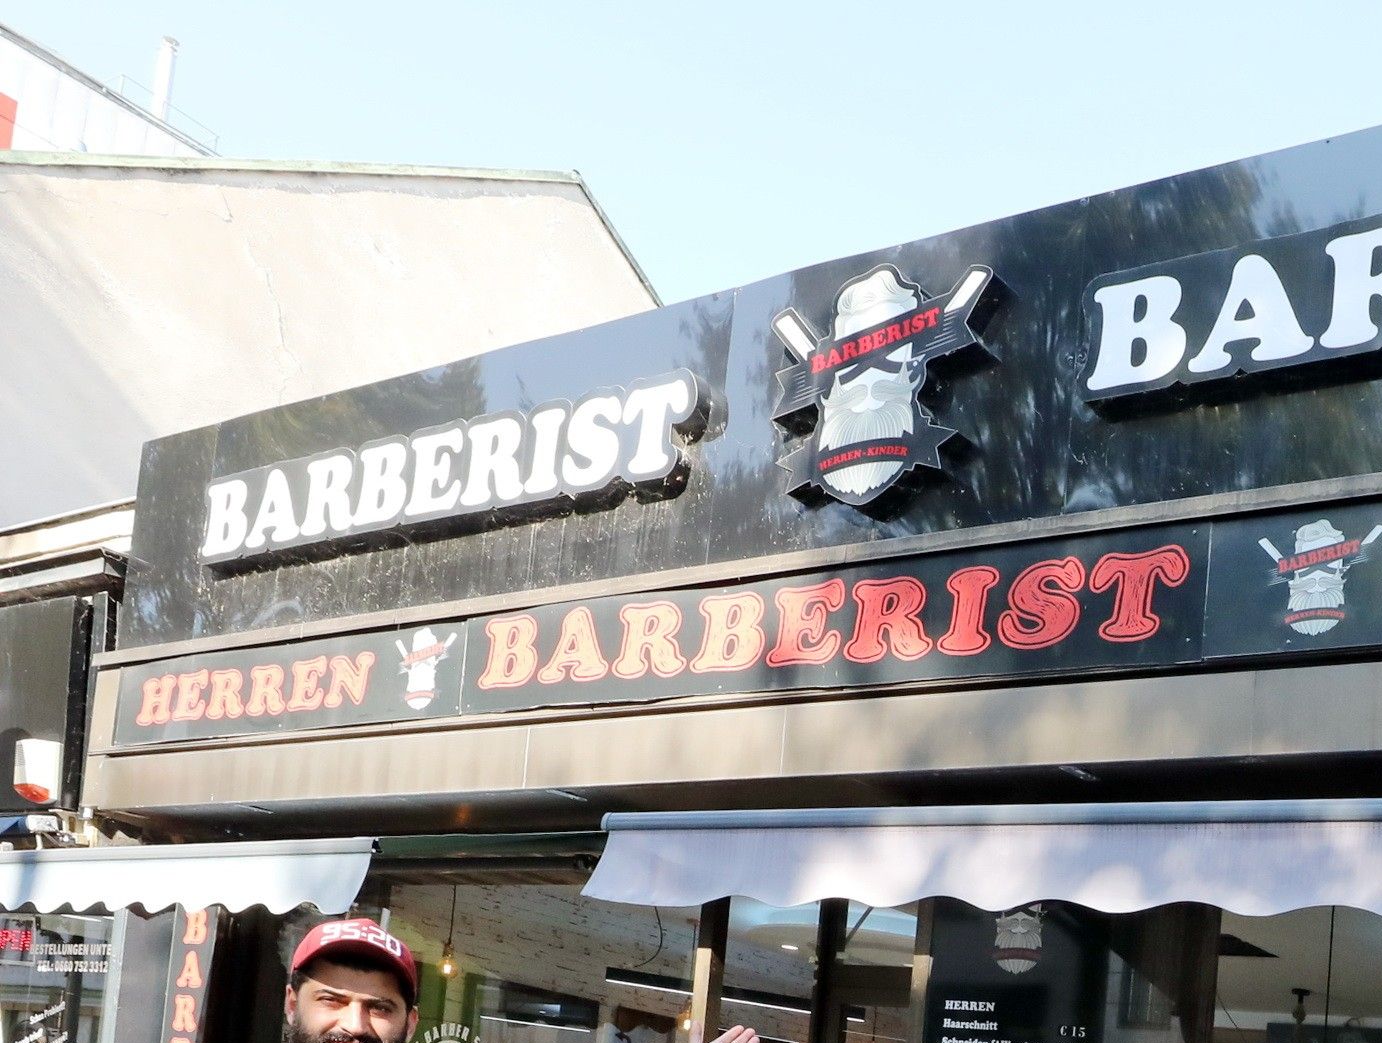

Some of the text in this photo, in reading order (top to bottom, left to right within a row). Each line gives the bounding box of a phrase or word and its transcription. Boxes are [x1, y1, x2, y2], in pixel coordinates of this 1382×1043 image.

[809, 307, 940, 374] BARBERIST
[202, 377, 690, 558] BARBERIST
[477, 543, 1190, 690] BARBERIST
[135, 651, 376, 727] HERREN
[90, 944, 115, 957] UNTE
[320, 921, 403, 957] 95:20
[75, 962, 88, 973] 752
[89, 962, 109, 973] 3312
[945, 1000, 995, 1013] HERREN
[943, 1018, 1086, 1038] Haarschnitt € 15
